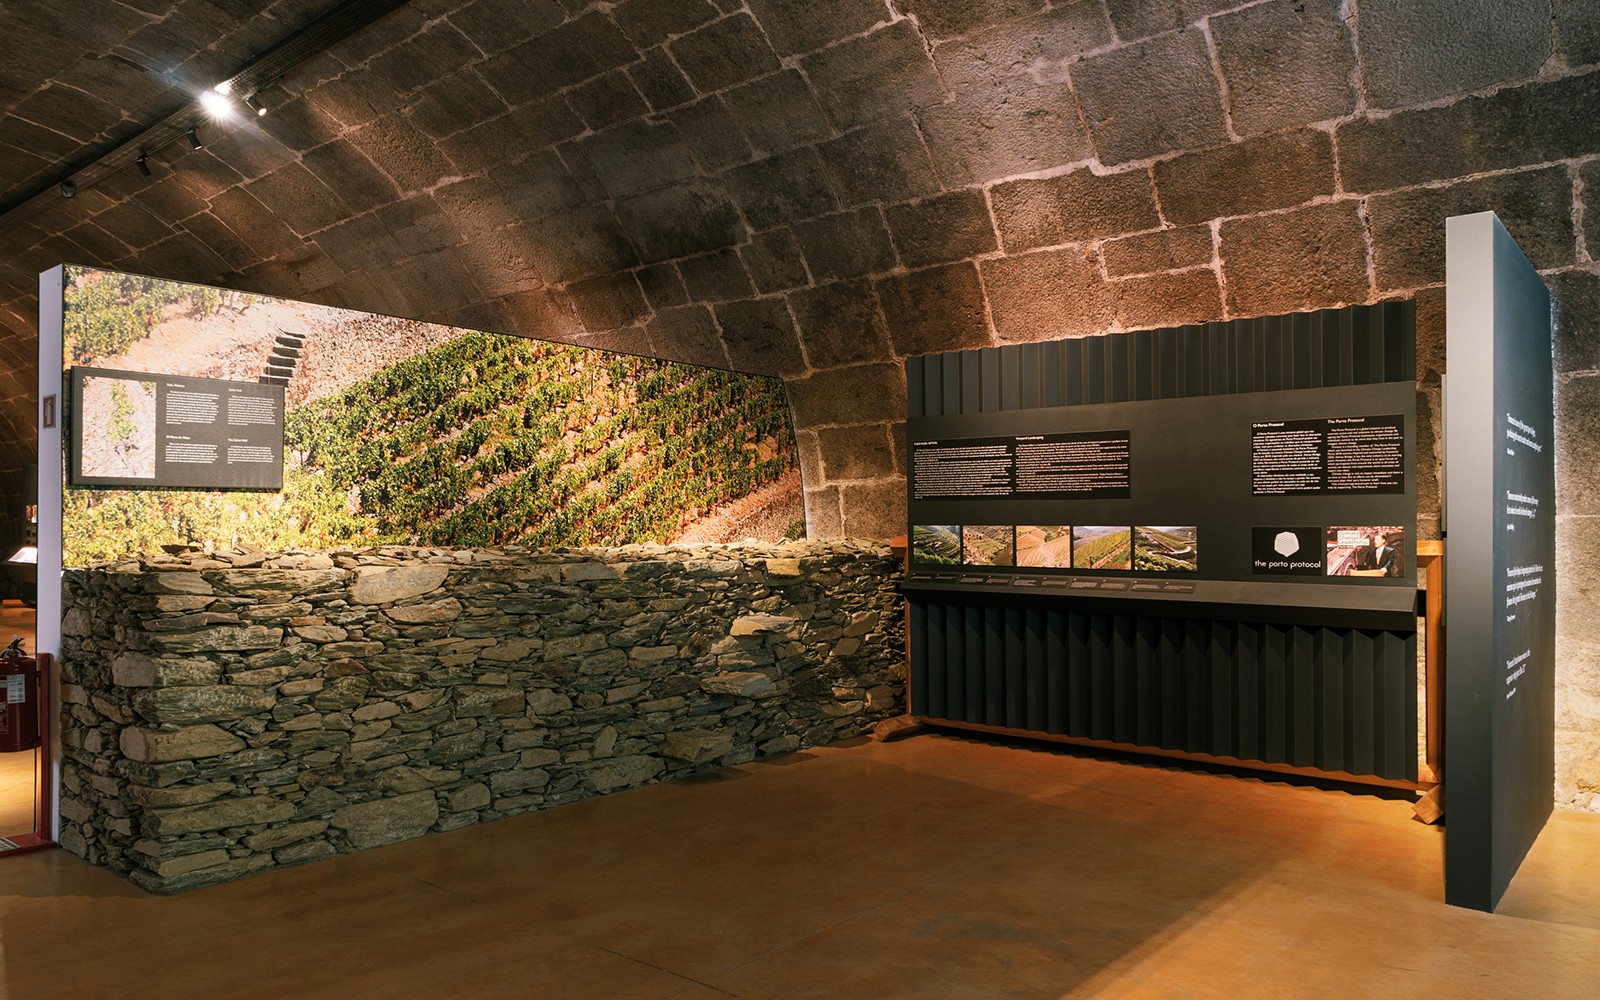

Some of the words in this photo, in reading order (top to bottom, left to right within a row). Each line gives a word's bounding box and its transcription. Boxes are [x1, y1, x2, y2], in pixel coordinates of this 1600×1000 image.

[1254, 559, 1267, 567] the
[1268, 561, 1288, 569] porto
[1290, 560, 1321, 570] protocol
